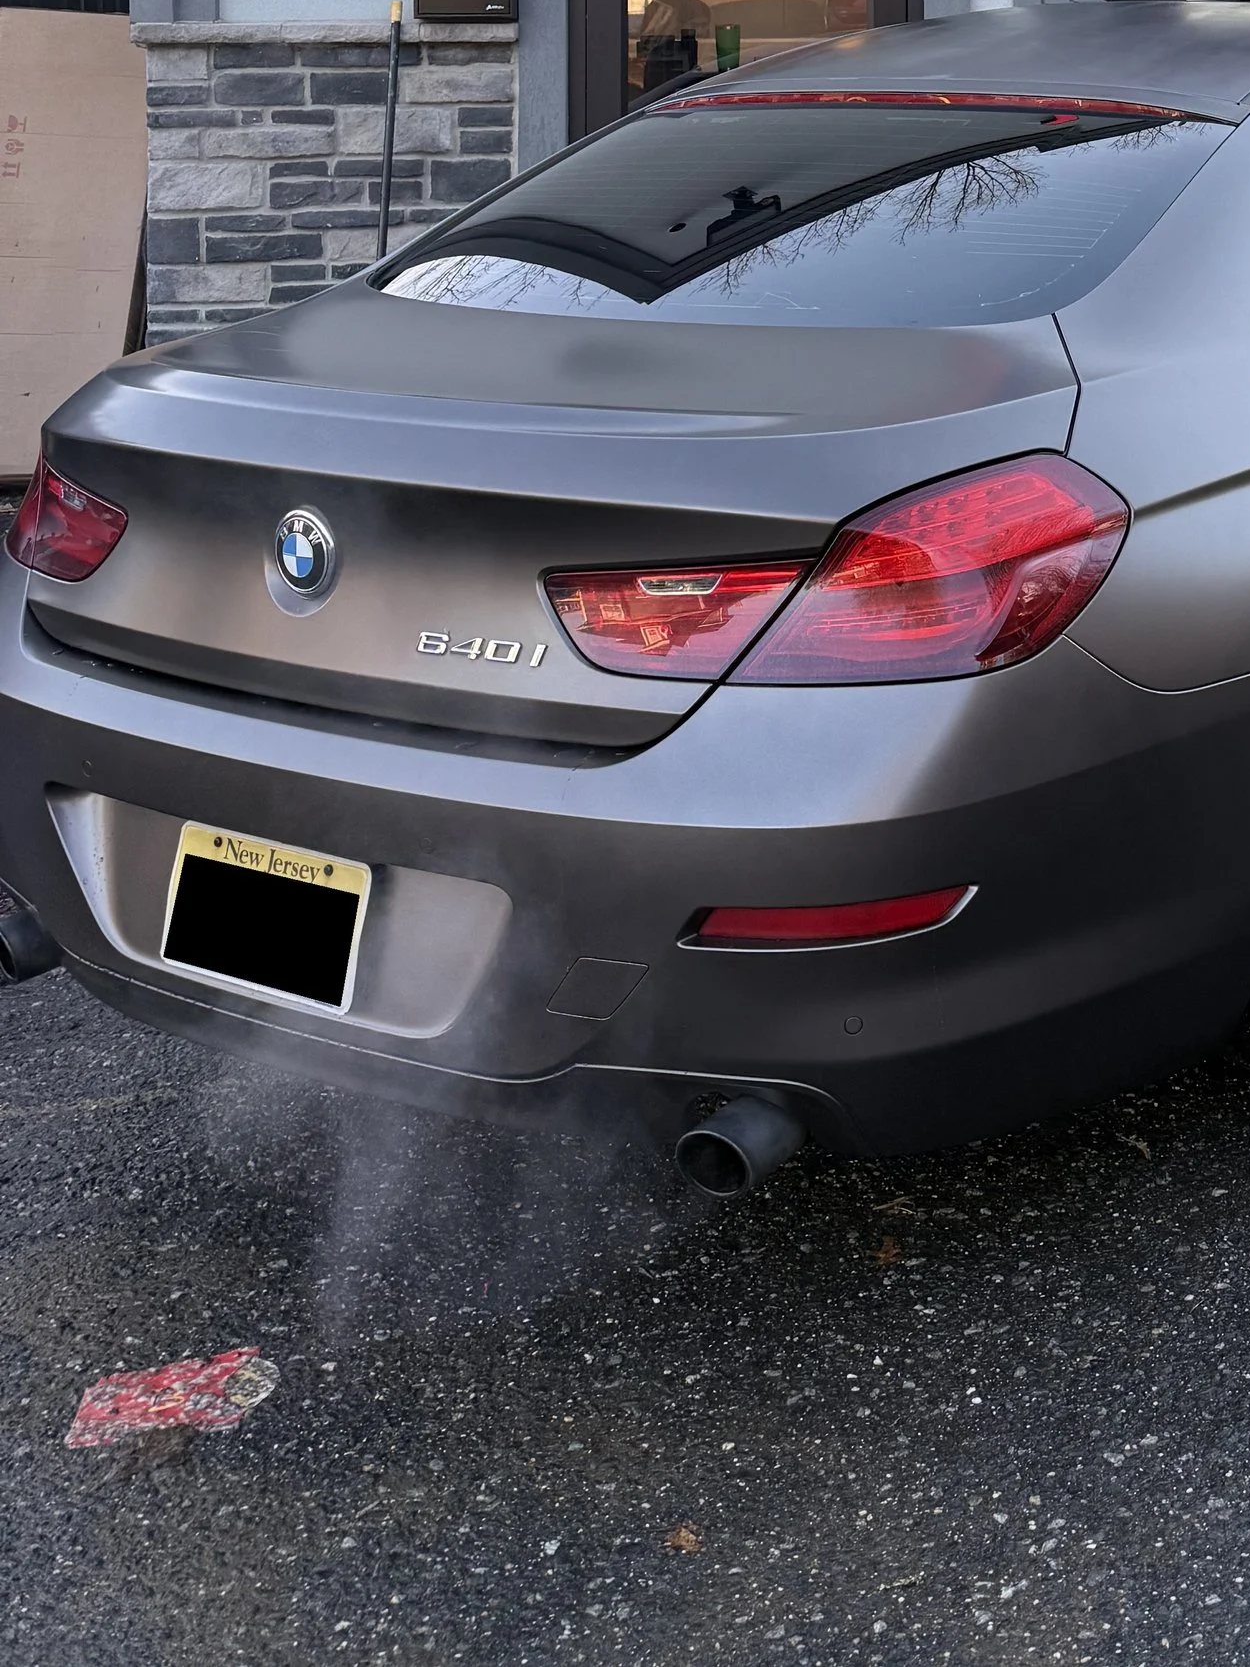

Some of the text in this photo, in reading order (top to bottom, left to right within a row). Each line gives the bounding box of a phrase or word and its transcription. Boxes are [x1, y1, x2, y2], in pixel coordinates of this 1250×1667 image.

[279, 519, 322, 546] BMW
[223, 837, 321, 884] New Jersey
